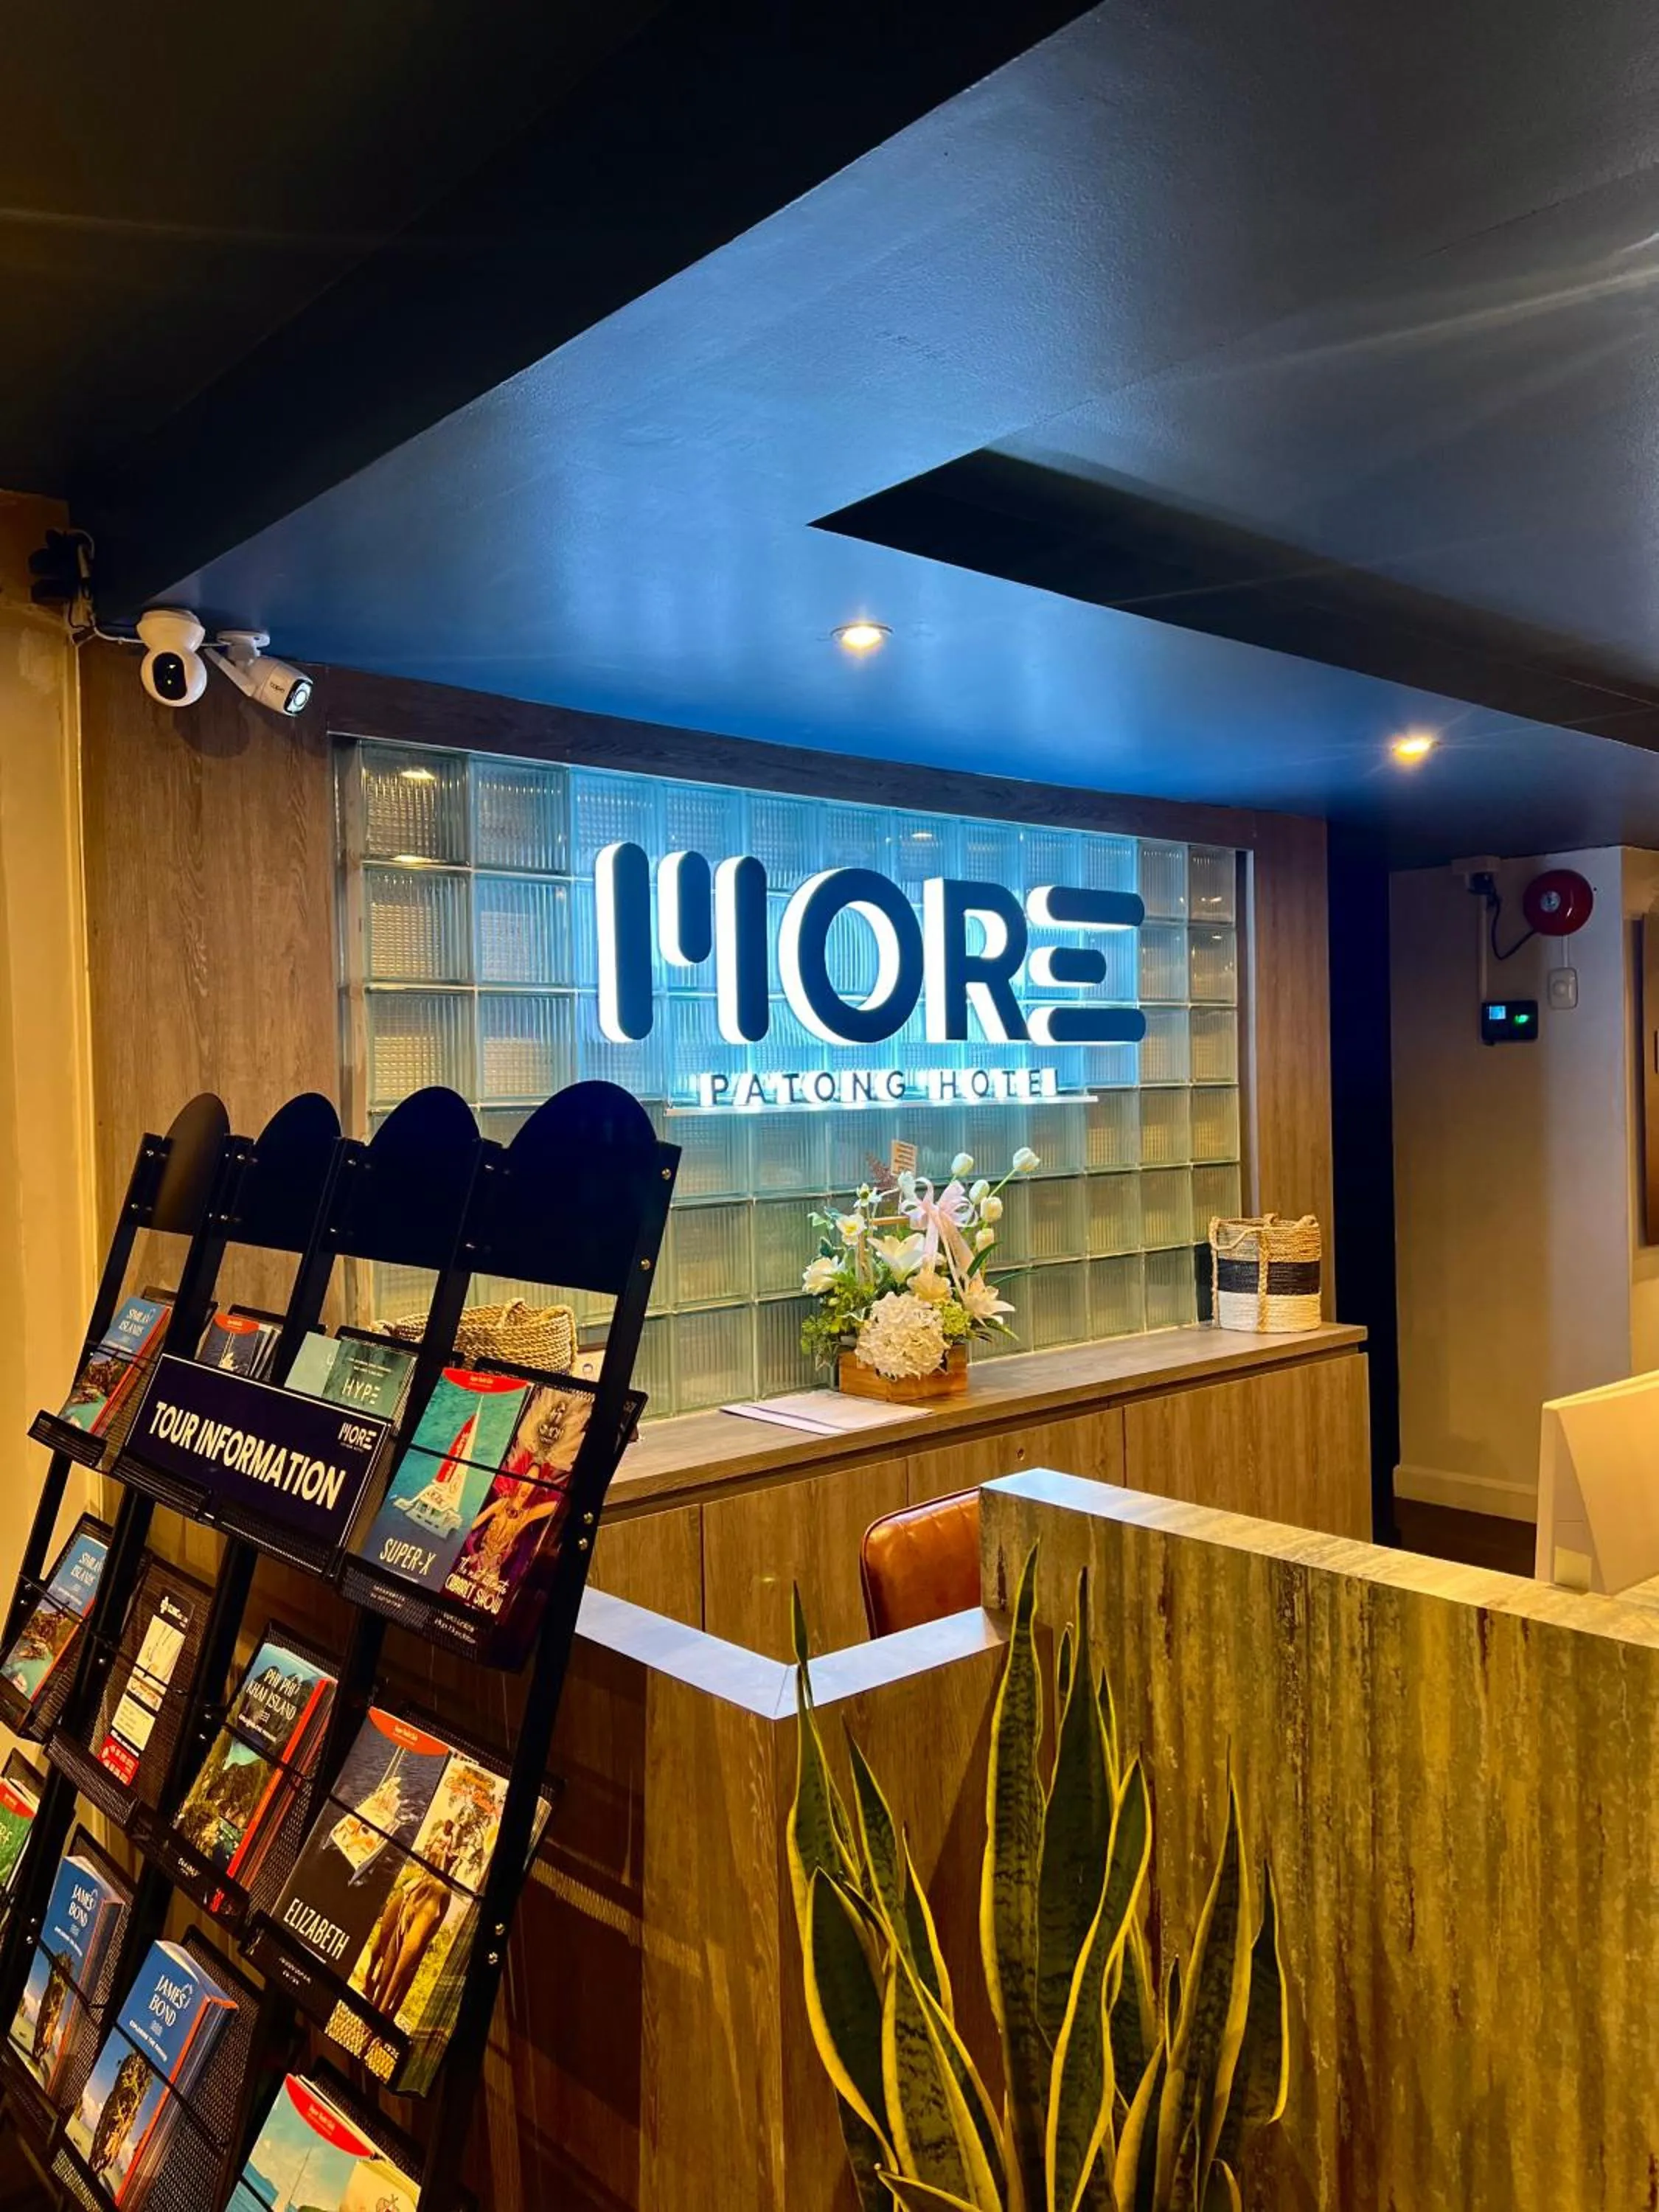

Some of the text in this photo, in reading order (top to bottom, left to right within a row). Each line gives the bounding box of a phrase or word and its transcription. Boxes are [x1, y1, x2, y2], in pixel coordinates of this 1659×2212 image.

[595, 842, 1146, 1045] MORE
[700, 1067, 1060, 1106] PATONG HOTEL
[341, 1377, 381, 1405] HYPE
[337, 1422, 378, 1450] MORE
[148, 1401, 347, 1511] TOUR INFORMATION
[379, 1537, 437, 1576] SUPER-X
[265, 1691, 297, 1721] ISLAND
[69, 1901, 88, 1928] BOND
[72, 1883, 94, 1912] JAMES
[283, 1896, 350, 1961] ELIZABETH
[153, 1974, 187, 2010] JAMES
[148, 1993, 177, 2027] BOND
